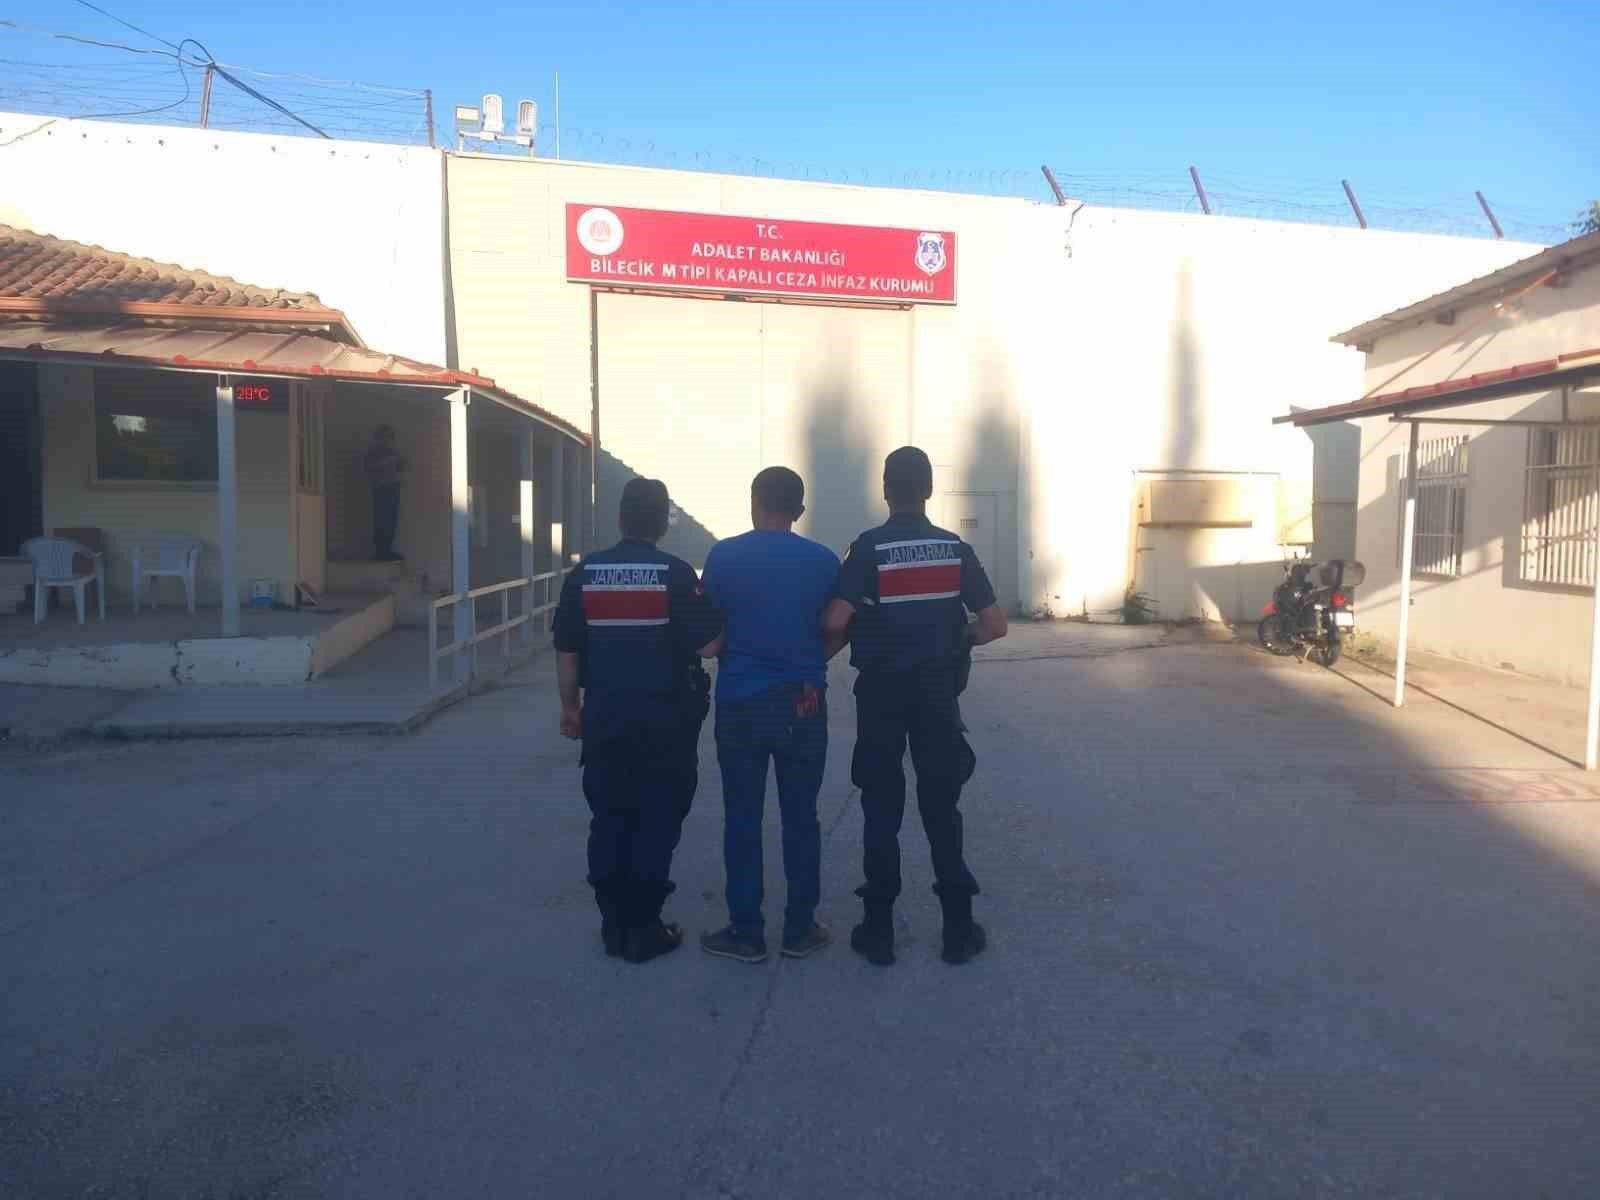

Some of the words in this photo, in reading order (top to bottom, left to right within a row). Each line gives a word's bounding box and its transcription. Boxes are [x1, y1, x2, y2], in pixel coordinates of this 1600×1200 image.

[755, 224, 783, 239] T.C.
[691, 242, 755, 260] ADALET
[760, 246, 846, 266] BAKANLIĞI
[590, 258, 655, 277] BİLECİK
[662, 264, 676, 278] M
[681, 262, 711, 281] TİPİ
[715, 268, 772, 285] KAPALI
[776, 272, 817, 288] CEZA
[821, 271, 865, 290] İNFAZ
[869, 277, 934, 293] KURUMU
[886, 544, 955, 564] JANDARMA
[591, 567, 660, 585] JANDARMA
